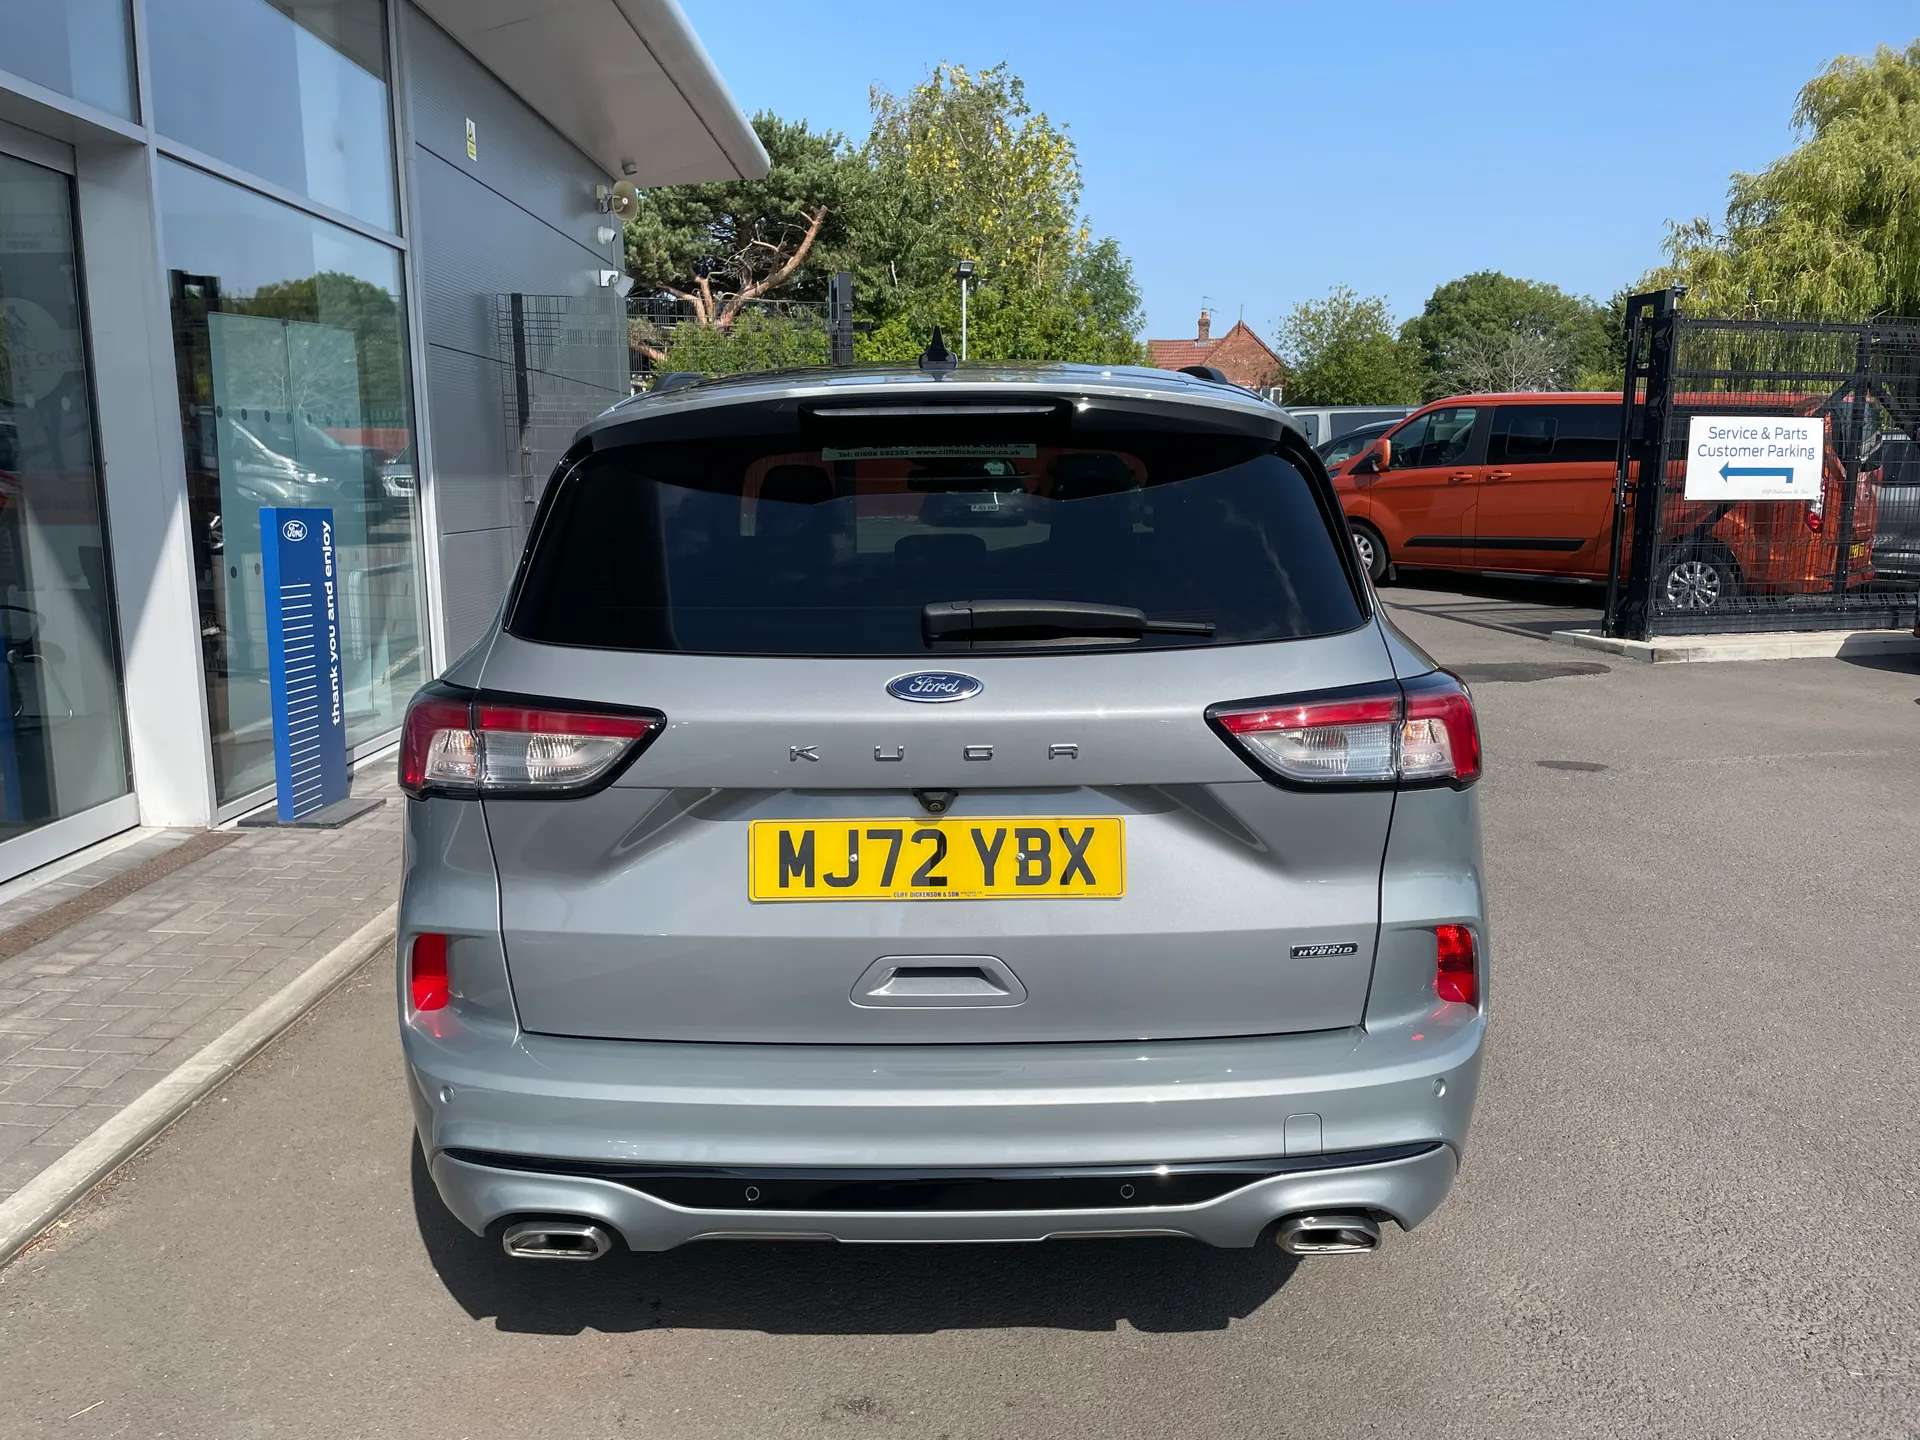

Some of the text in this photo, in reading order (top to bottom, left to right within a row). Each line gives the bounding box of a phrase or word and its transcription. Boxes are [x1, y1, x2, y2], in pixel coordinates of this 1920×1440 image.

[1708, 426, 1807, 440] Service & Parts
[1697, 444, 1815, 460] Customer Parking
[285, 522, 305, 539] Ford
[322, 520, 341, 726] thank you and enjoy
[908, 676, 960, 693] Ford
[789, 743, 1080, 762] KUGA
[778, 827, 1096, 889] MJ72 YBX
[1298, 946, 1353, 956] HYBRID
